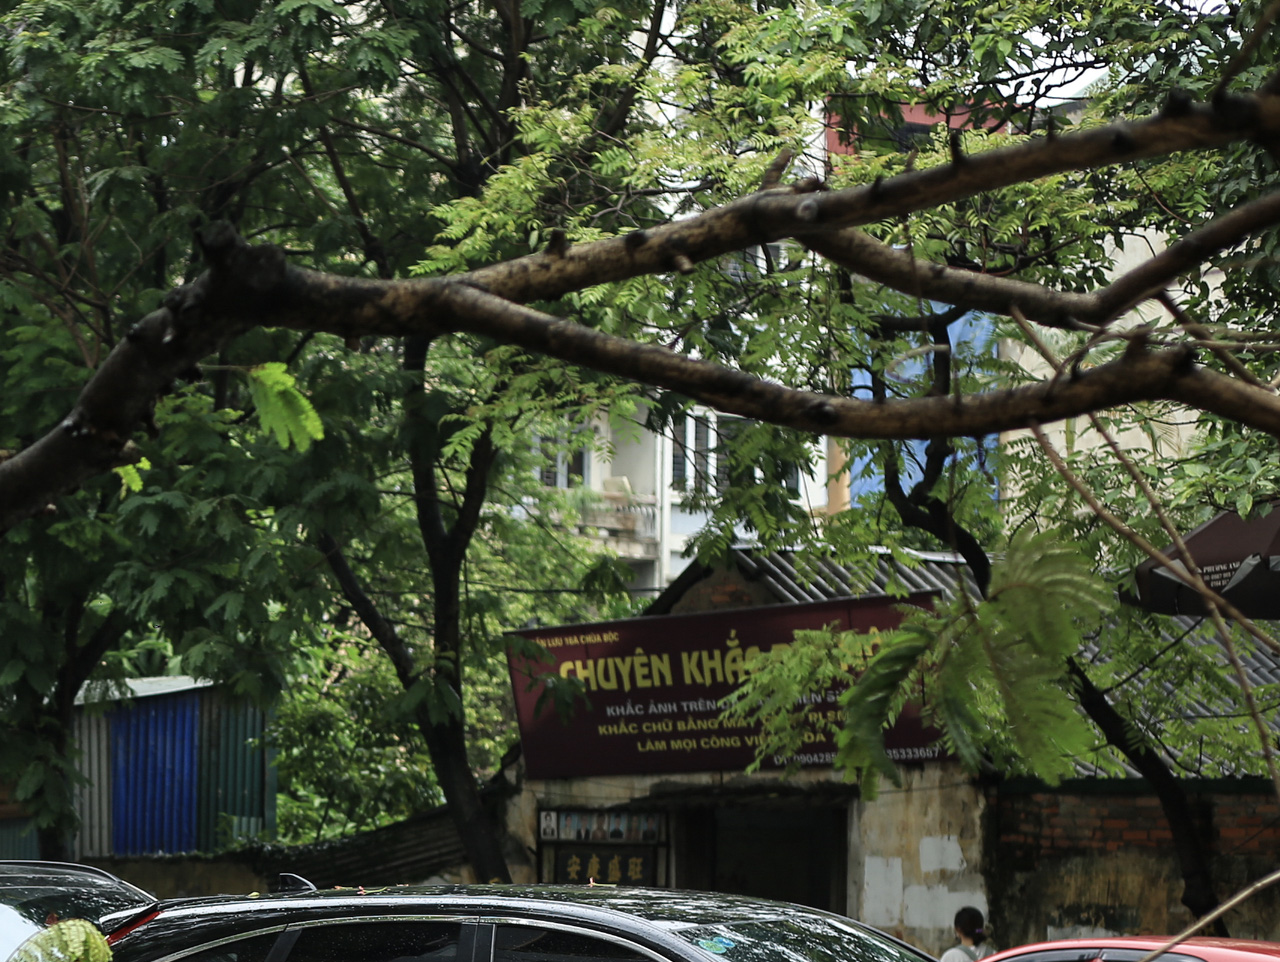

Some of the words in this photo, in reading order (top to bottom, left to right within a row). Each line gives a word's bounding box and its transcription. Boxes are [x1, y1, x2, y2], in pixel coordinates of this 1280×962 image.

[559, 647, 673, 693] CHUYÊN
[606, 698, 645, 716] KHẮC
[683, 695, 717, 713] TRÊN
[598, 717, 639, 736] KHẮC
[671, 738, 697, 754] MỌI
[700, 734, 741, 749] CÔNG
